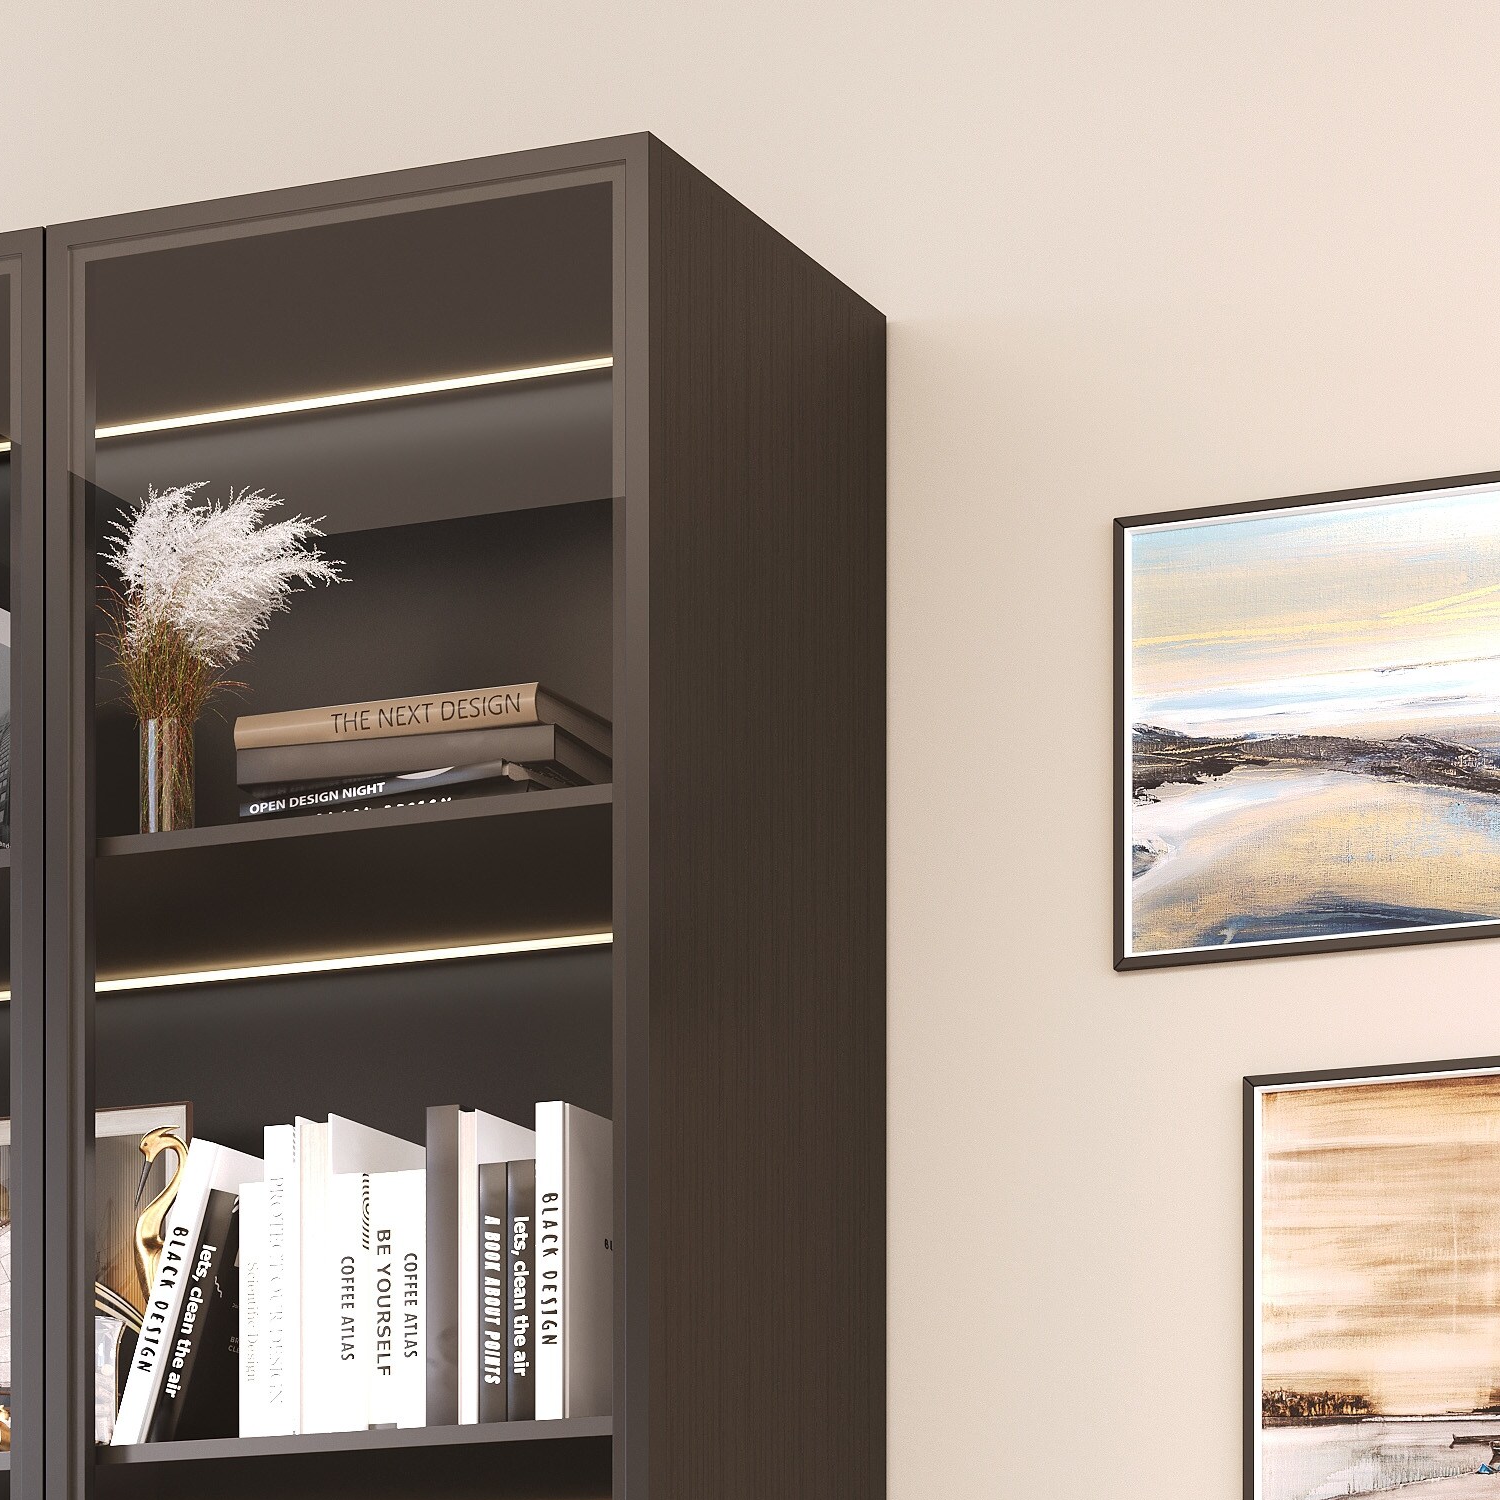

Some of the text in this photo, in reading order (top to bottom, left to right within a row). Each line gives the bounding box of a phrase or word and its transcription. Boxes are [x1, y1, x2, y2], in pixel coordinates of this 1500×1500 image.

[331, 693, 521, 734] THE NEXT DESIGN
[249, 798, 286, 814] OPEN
[289, 790, 339, 809] DESIGN
[342, 782, 386, 803] NIGHT
[137, 1226, 189, 1373] BLACK DESIGN
[165, 1244, 218, 1399] lets, clean the air
[341, 1256, 355, 1361] COFFEE ATLAS
[377, 1229, 391, 1375] BE YOURSELF
[404, 1253, 417, 1358] COFFEE ATLAS
[484, 1215, 501, 1385] A BOOK ABOUT POINTS
[510, 1216, 530, 1377] lets, clean the air
[541, 1192, 559, 1345] BLACK DESIGN
